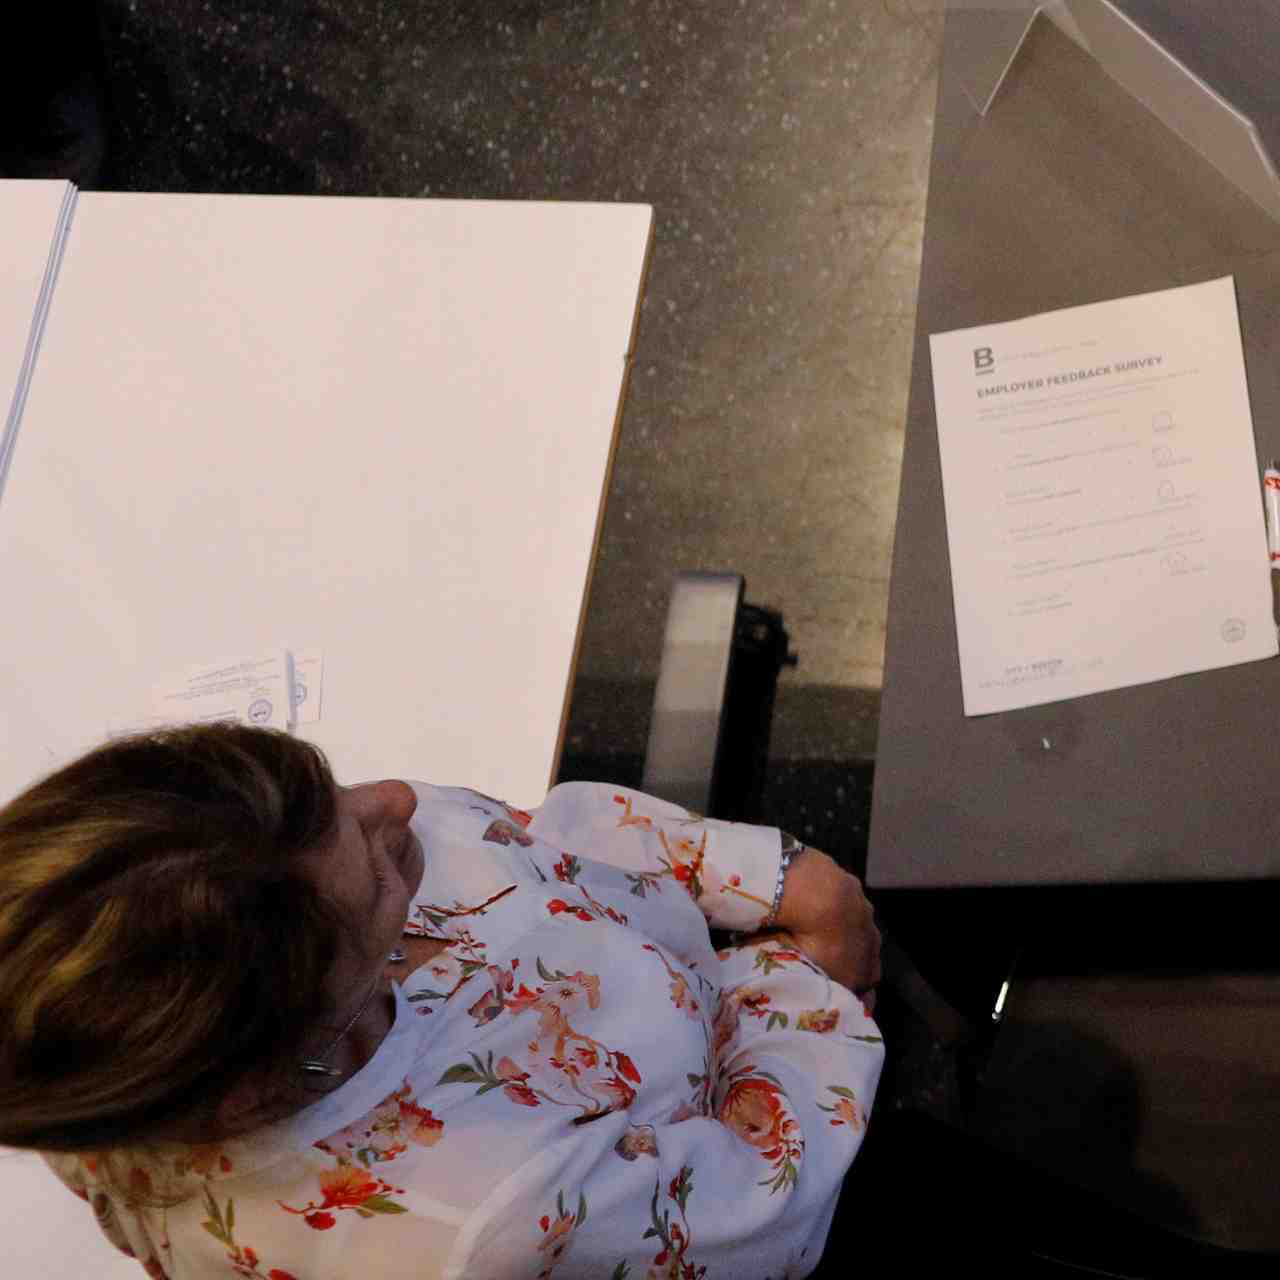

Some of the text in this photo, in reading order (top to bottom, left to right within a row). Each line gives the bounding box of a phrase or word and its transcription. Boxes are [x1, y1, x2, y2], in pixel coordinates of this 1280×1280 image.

[973, 347, 994, 369] B
[978, 357, 1163, 398] EMPLOYER FEEDBACK SURVEY
